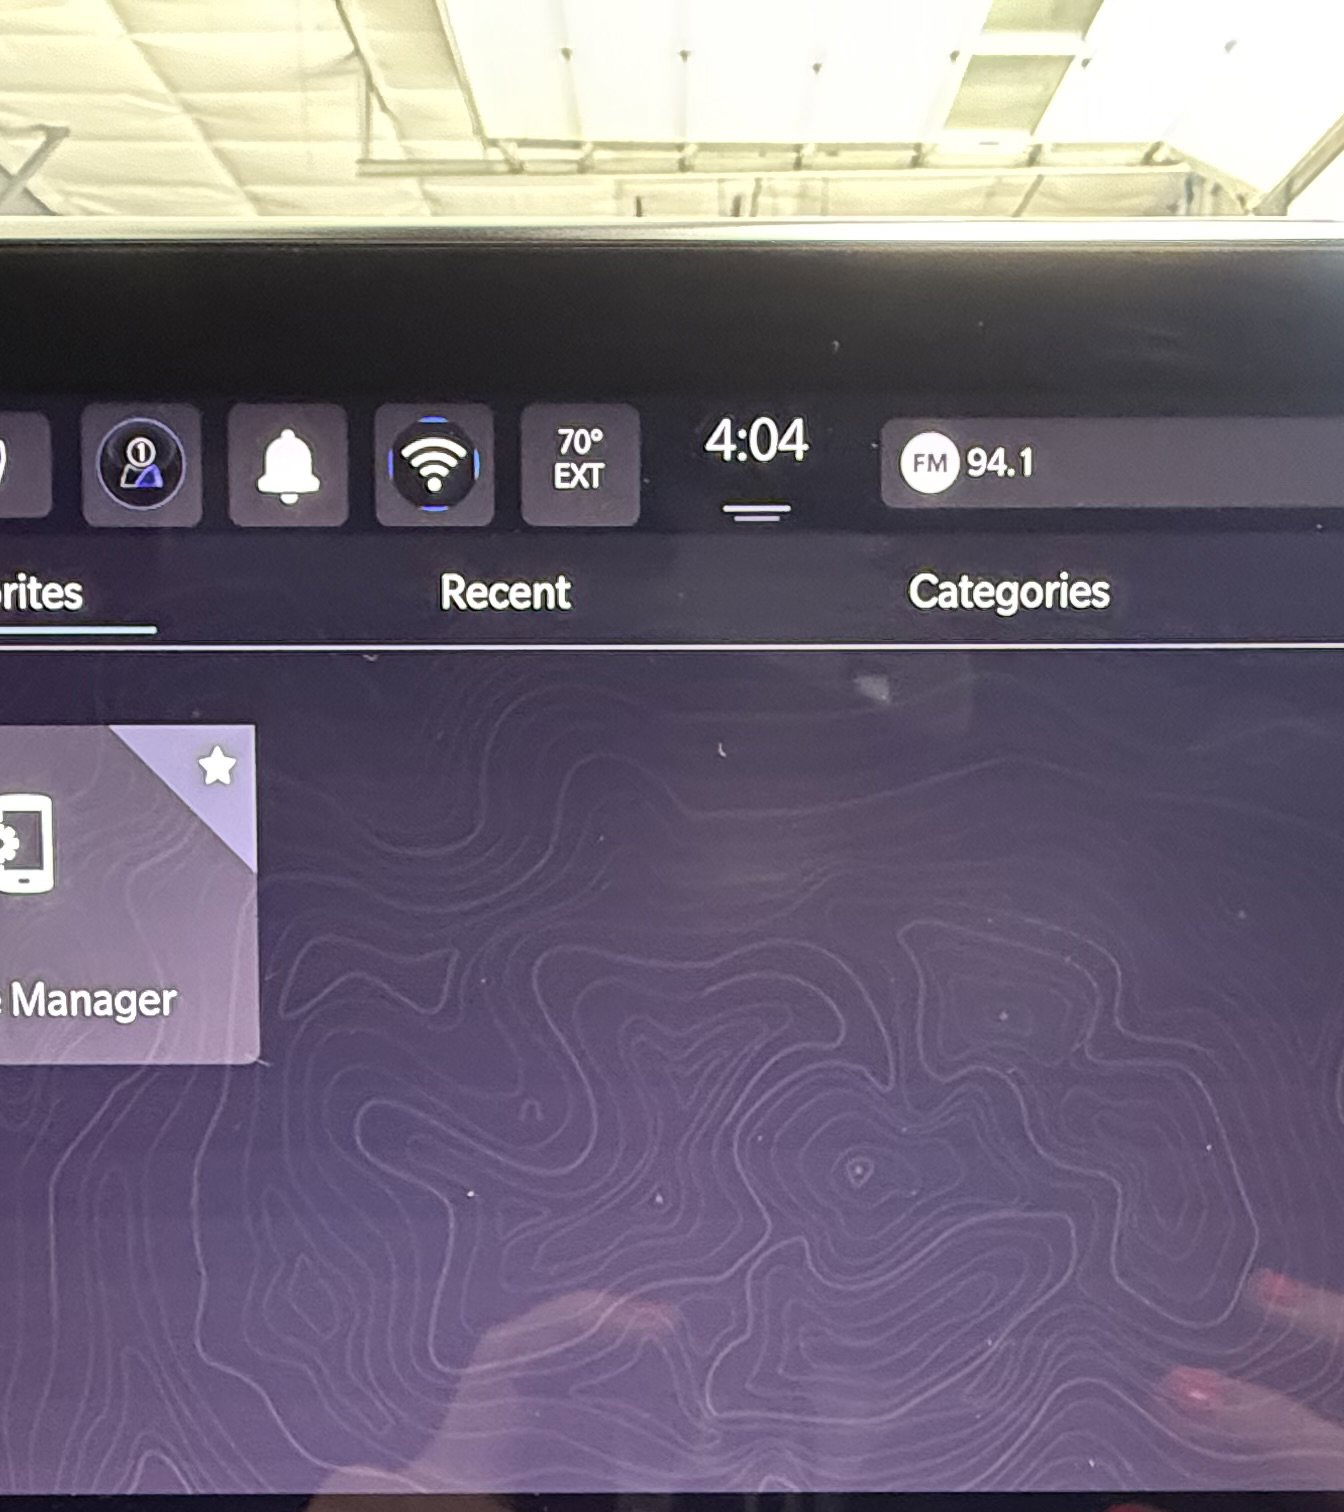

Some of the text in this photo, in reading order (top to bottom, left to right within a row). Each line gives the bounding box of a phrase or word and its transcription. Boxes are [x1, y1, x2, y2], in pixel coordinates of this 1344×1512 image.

[557, 428, 604, 455] 70°
[705, 416, 810, 462] 4:04
[554, 462, 606, 489] EXT
[912, 446, 1032, 477] FM 94.1
[441, 572, 572, 610] Recent
[909, 571, 1111, 617] Categories
[11, 981, 178, 1024] Manager
